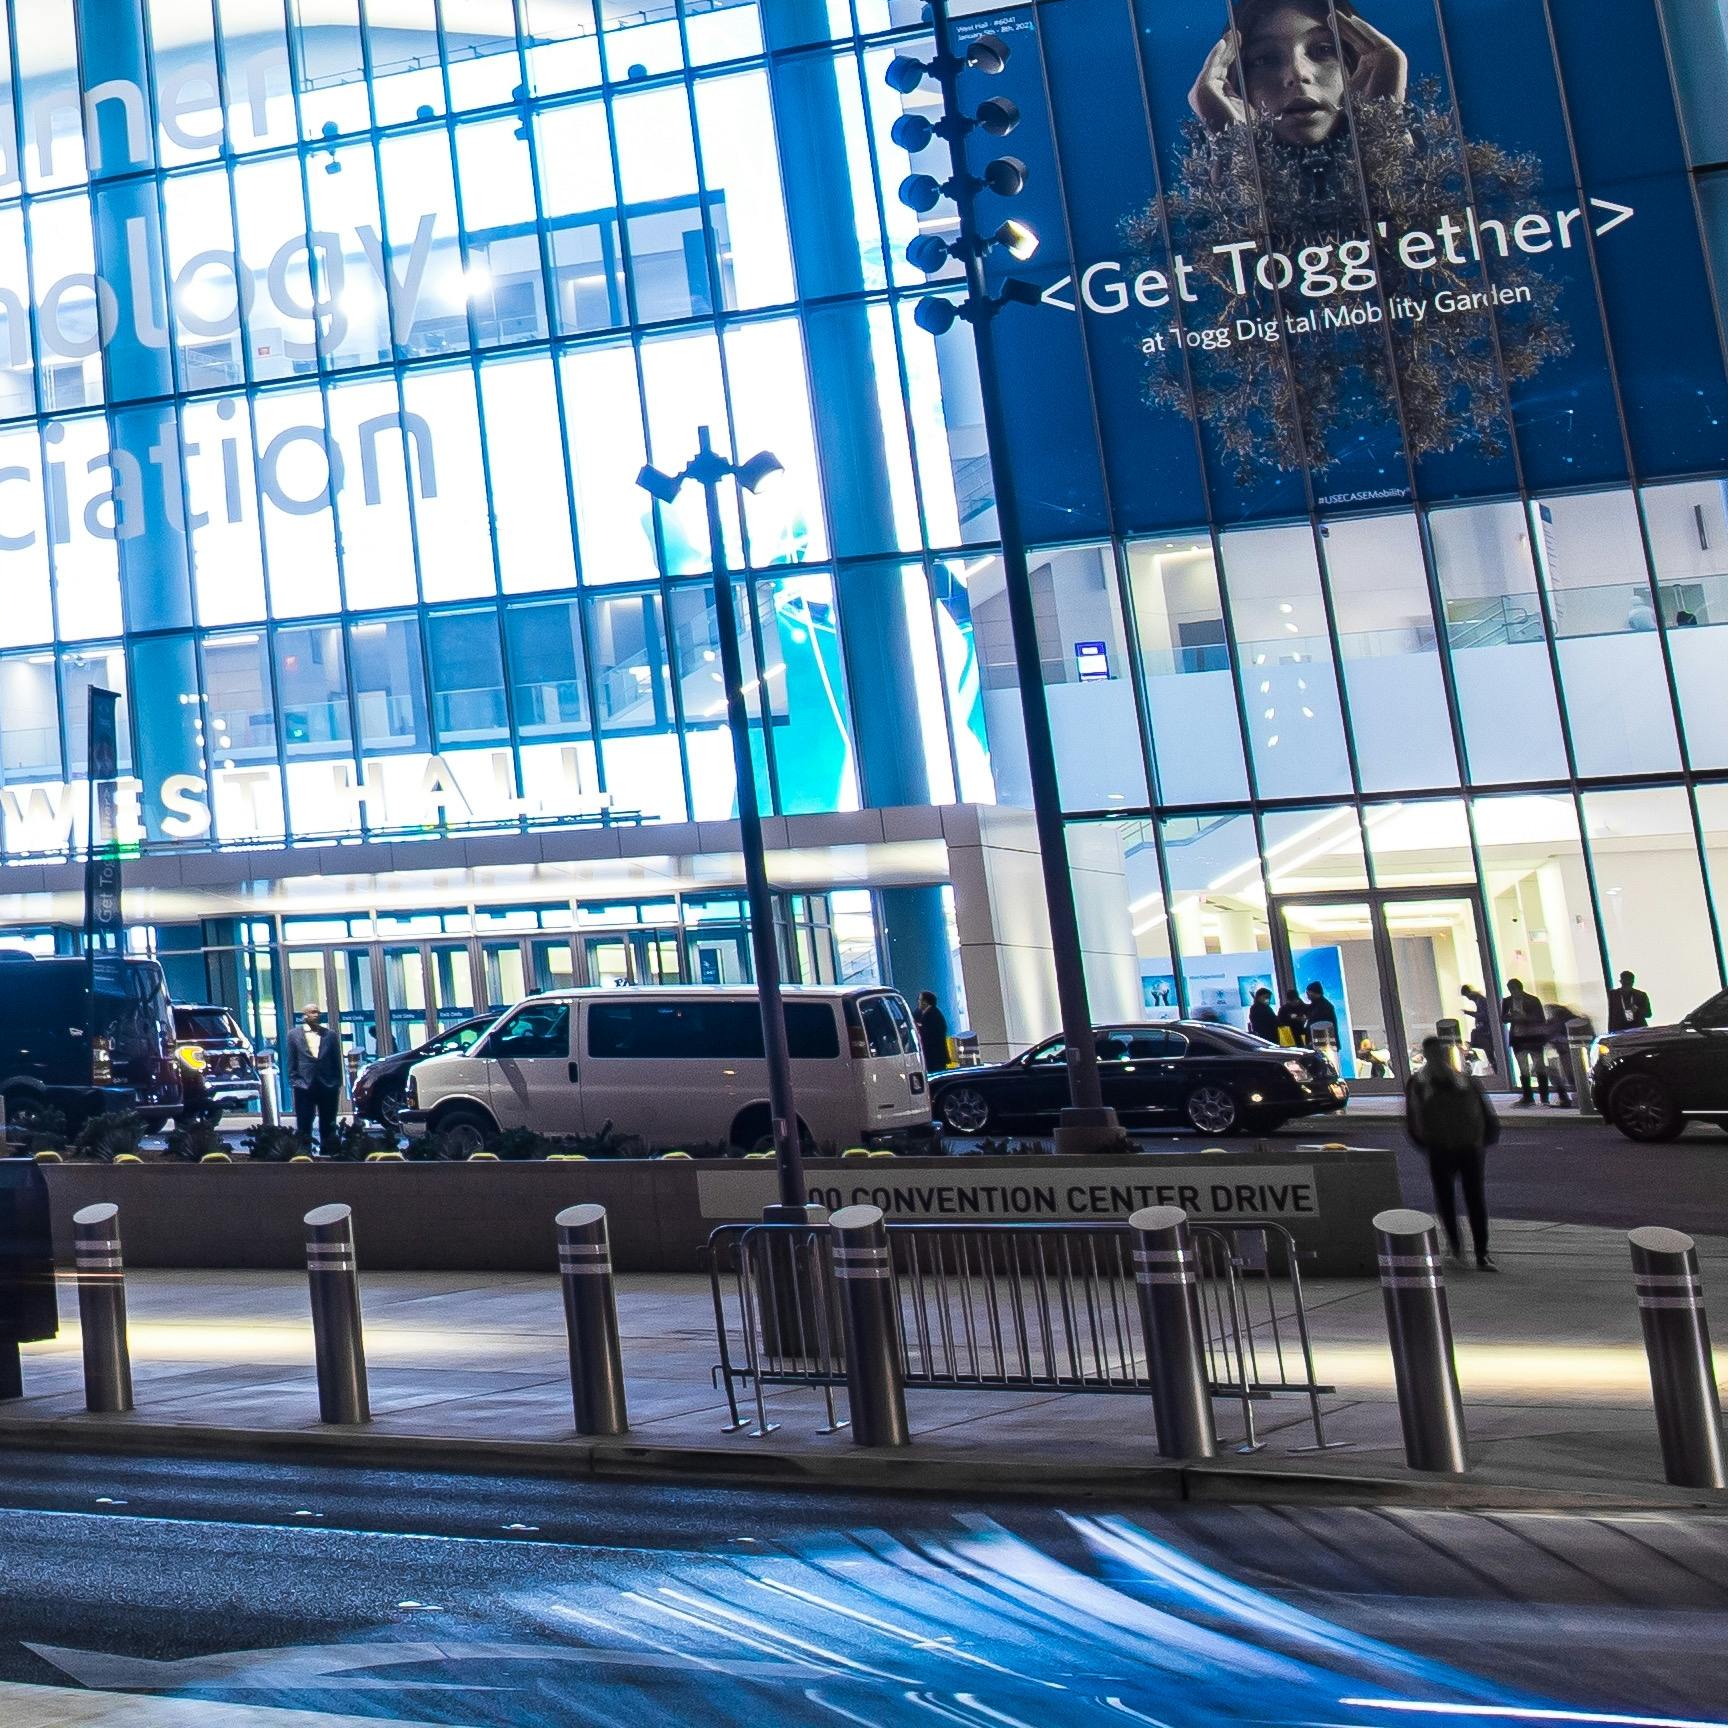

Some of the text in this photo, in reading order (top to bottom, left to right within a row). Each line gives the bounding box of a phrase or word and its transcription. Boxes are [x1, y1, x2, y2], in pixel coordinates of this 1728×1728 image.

[1142, 333, 1165, 354] at
[1237, 313, 1317, 344] Digtal
[1323, 297, 1428, 330] Moblity
[332, 745, 614, 826] HALL
[851, 1186, 1058, 1213] CONVENTION
[1066, 1184, 1202, 1213] CENTER
[1210, 1183, 1314, 1213] DRIVE
